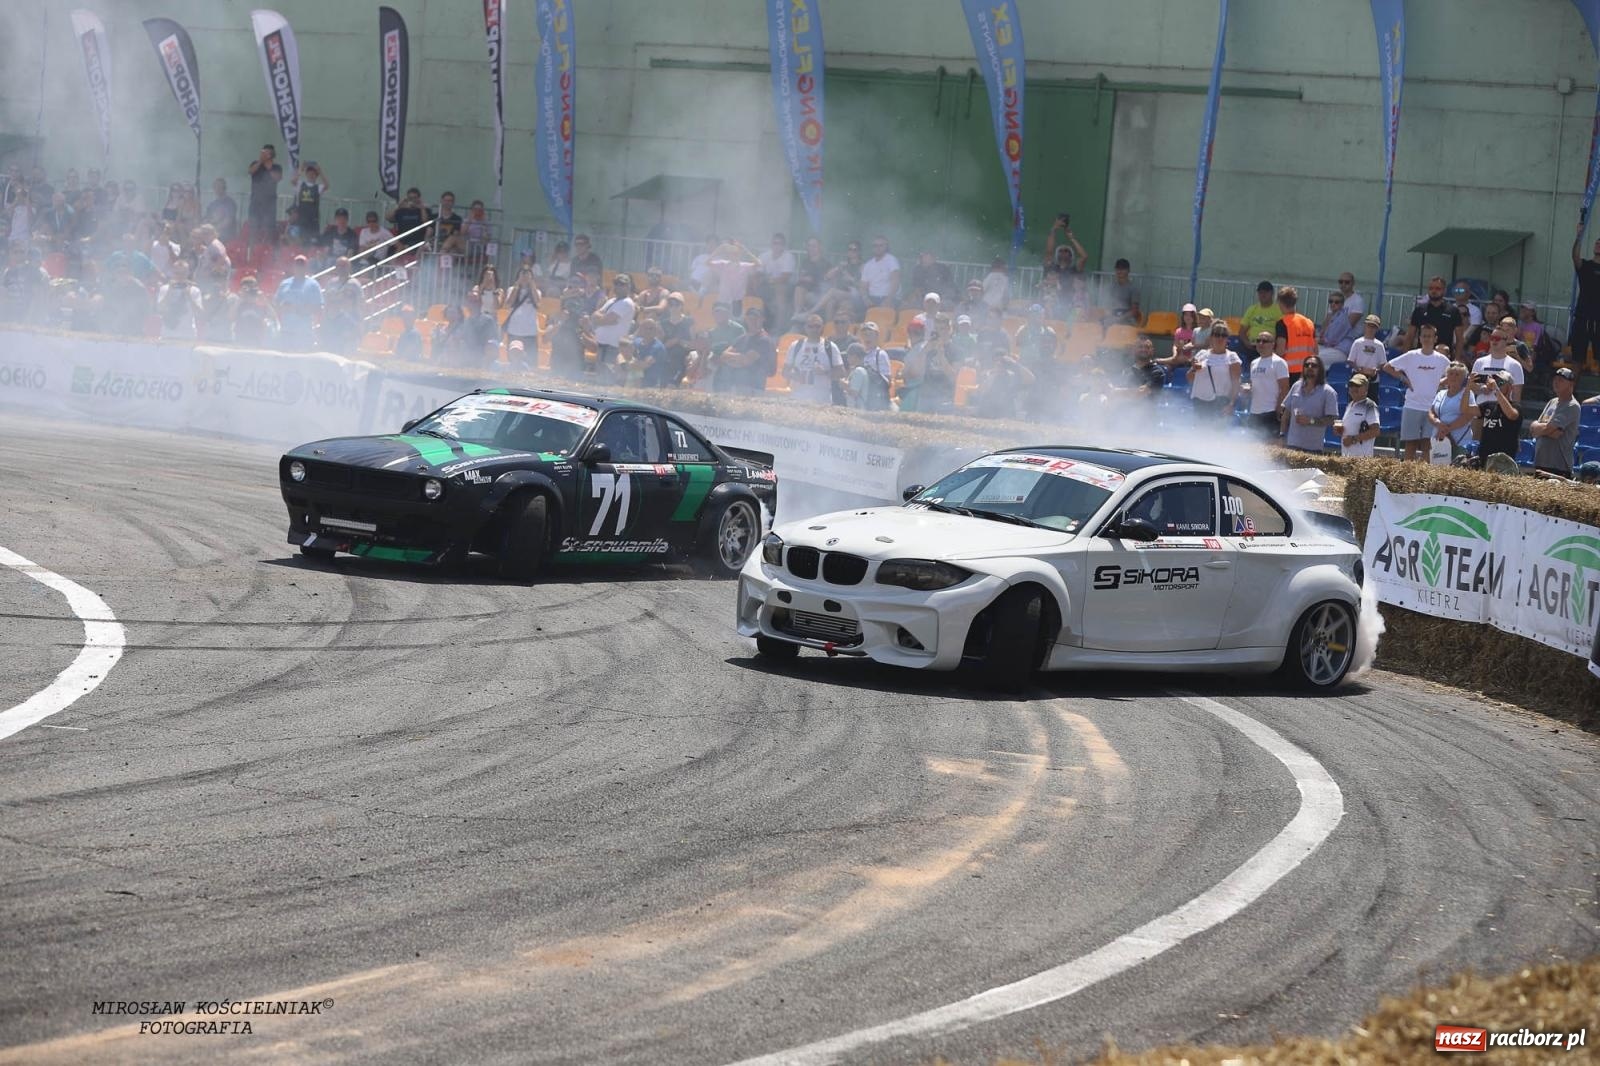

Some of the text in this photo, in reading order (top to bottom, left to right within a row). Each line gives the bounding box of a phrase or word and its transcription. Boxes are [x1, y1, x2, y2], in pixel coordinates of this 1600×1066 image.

[673, 431, 688, 448] 71
[866, 453, 896, 469] SERWIS
[464, 469, 480, 480] MAX
[591, 473, 631, 536] 71
[1222, 496, 1244, 516] 100
[1175, 523, 1210, 531] KAMIL SIKORA
[1152, 583, 1199, 592] MOTORSPORT
[1417, 589, 1460, 611] KIETRZ
